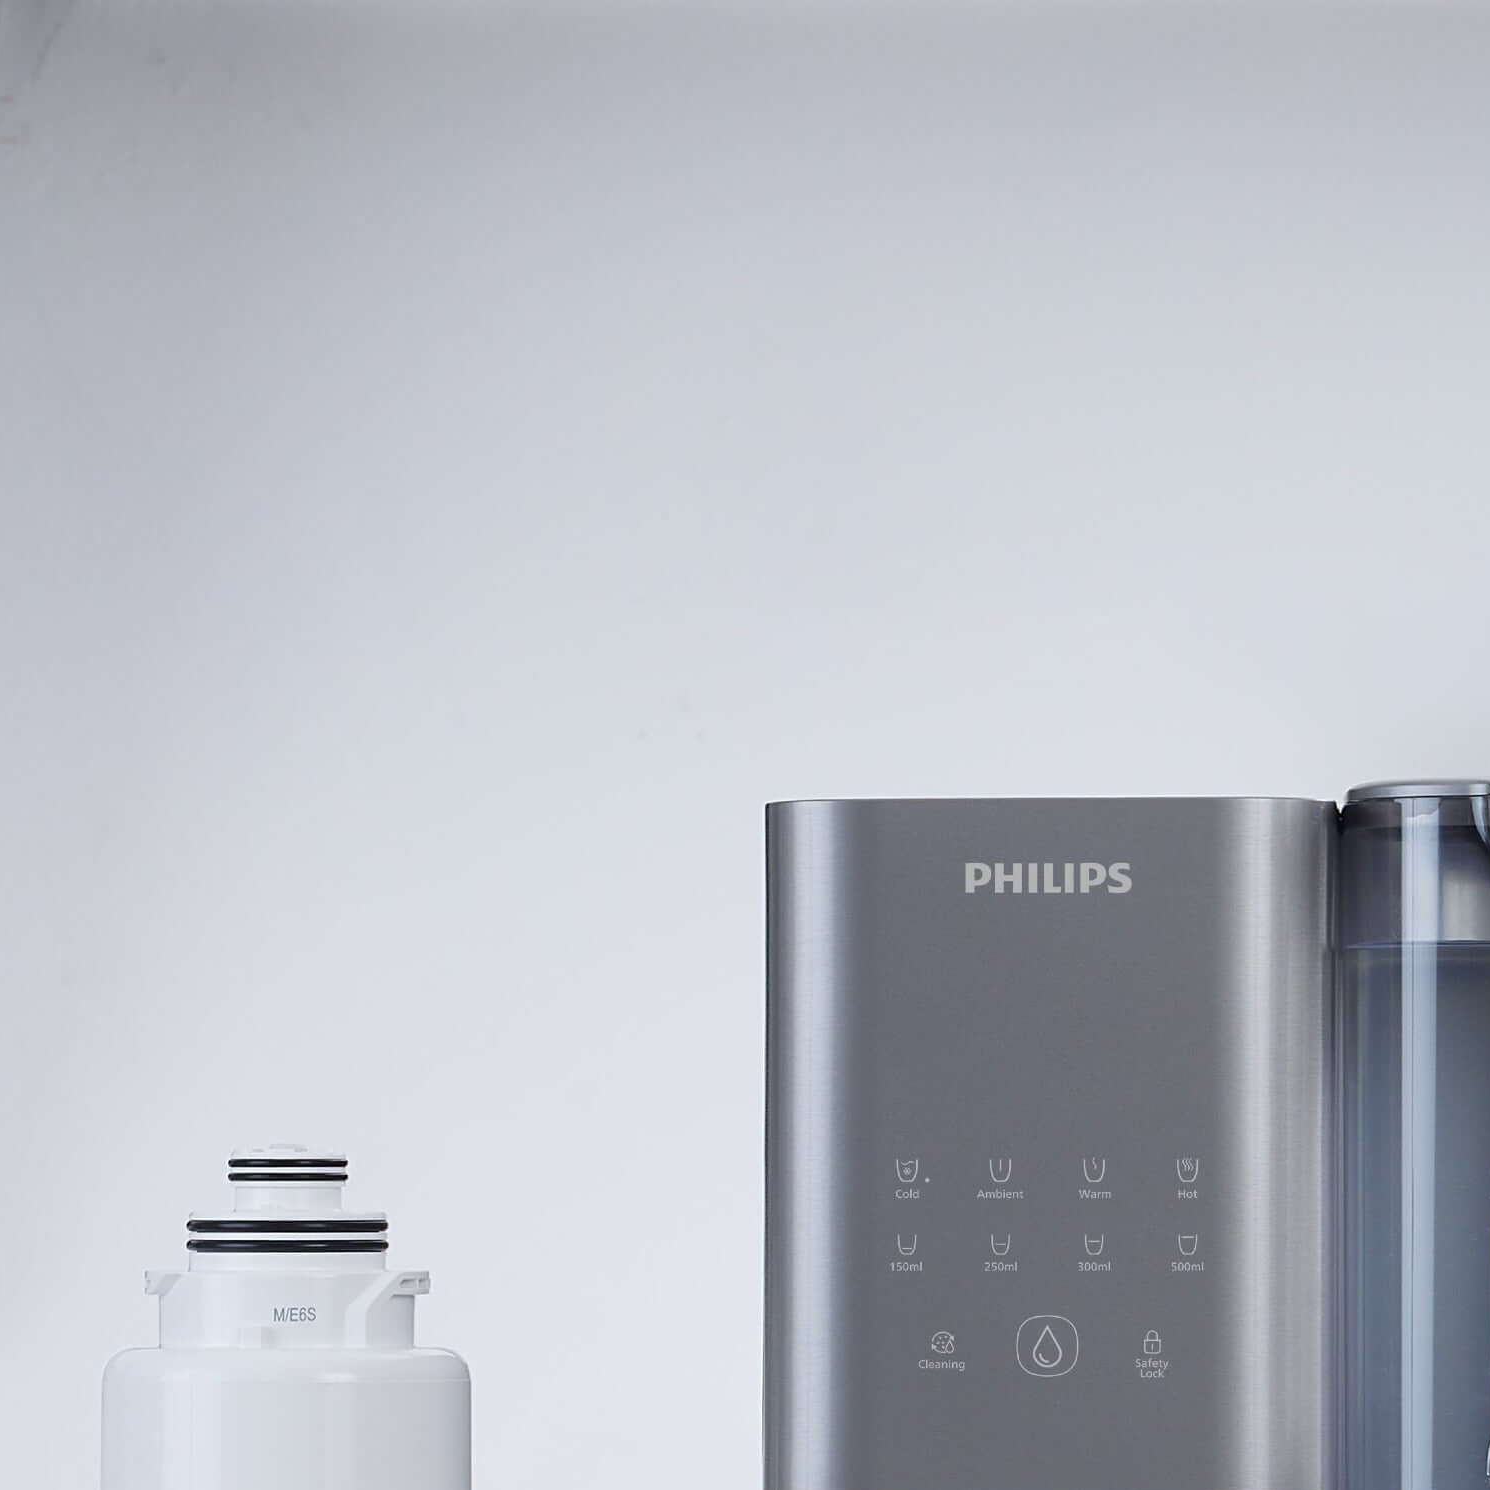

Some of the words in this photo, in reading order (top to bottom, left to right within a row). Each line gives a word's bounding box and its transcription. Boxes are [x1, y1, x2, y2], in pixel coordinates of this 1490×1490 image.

[965, 862, 1132, 893] PHILIPS
[894, 1188, 920, 1200] Cold
[977, 1188, 1024, 1200] Ambient
[1078, 1188, 1111, 1200] Warm
[1177, 1188, 1197, 1200] Hot
[890, 1261, 922, 1272] 150ml
[985, 1261, 1017, 1272] 250ml
[1078, 1261, 1111, 1272] 300ml
[1171, 1261, 1204, 1272] 500ml
[273, 1307, 317, 1322] M/E6S
[918, 1359, 965, 1371] Cleaning
[1135, 1358, 1168, 1369] Safety
[1140, 1369, 1164, 1378] Lock
